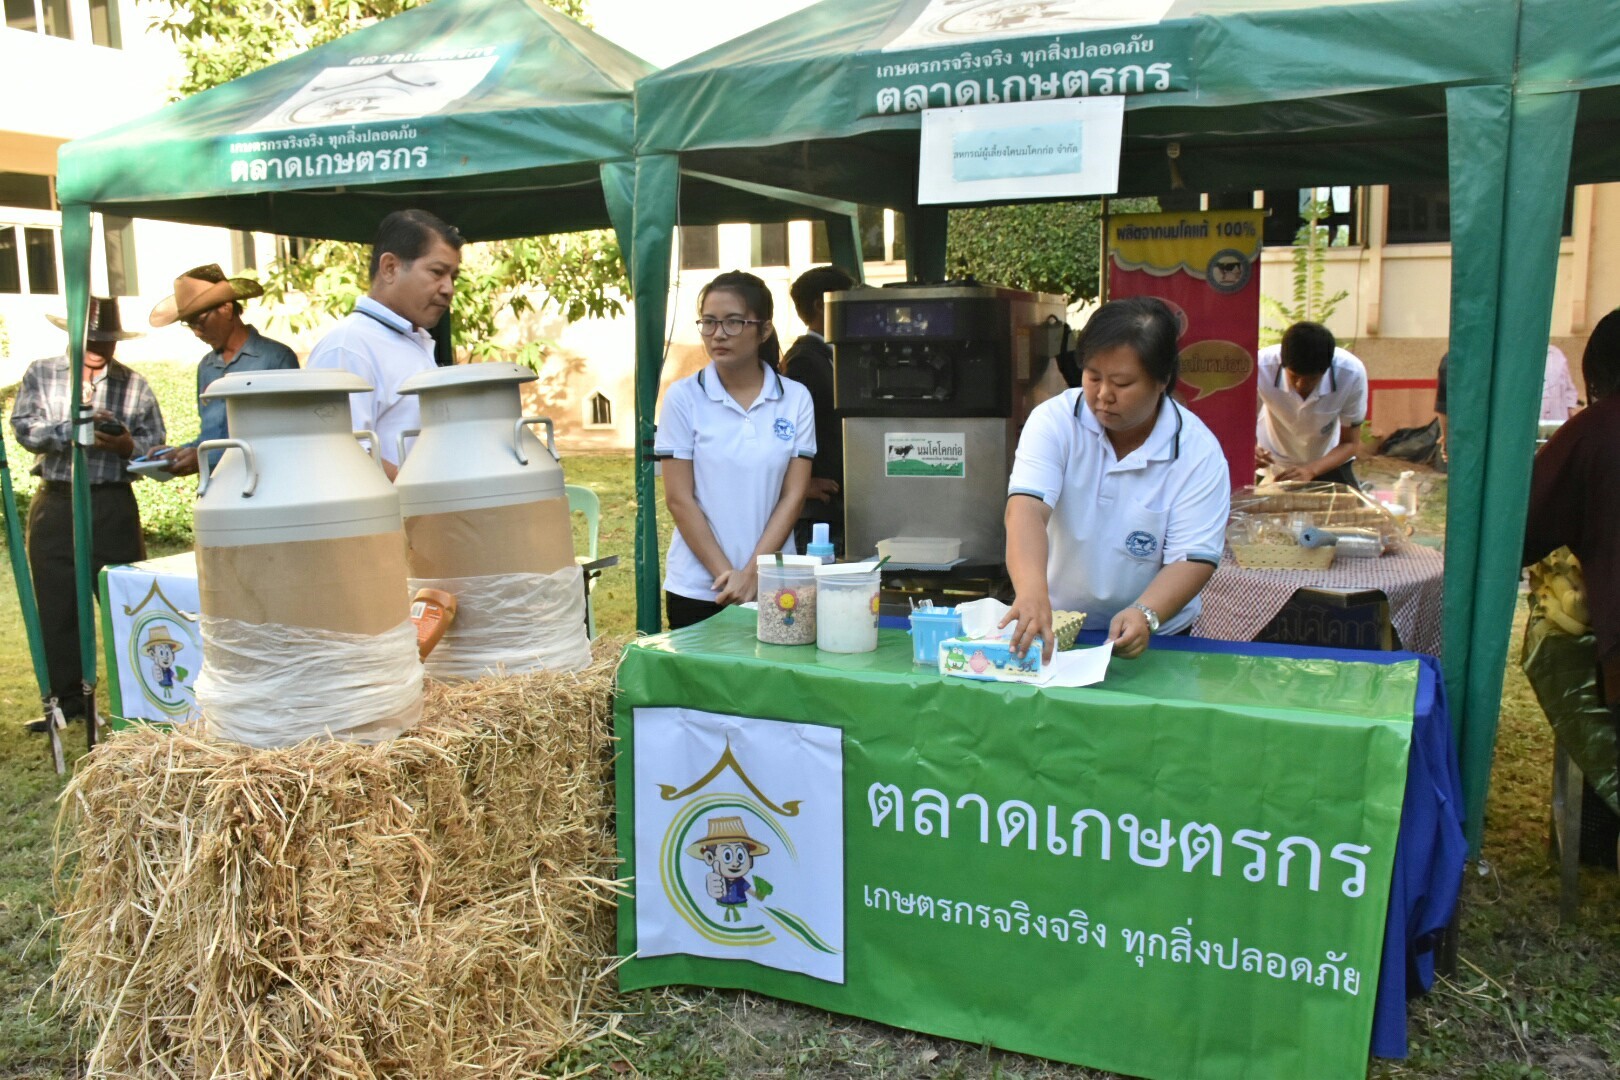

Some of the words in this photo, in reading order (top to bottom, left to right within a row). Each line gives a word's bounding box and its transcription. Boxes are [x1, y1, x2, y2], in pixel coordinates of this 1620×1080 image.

[876, 47, 1013, 79] เกษตรกรจริงจริง
[1020, 33, 1154, 69] ทุกสิ่งปลอดภัย
[876, 62, 1172, 114] ตลาดเกษตรกร
[328, 124, 417, 150] ทุกสิ่งปลอดภัย
[230, 145, 429, 183] ตลาดเกษตรกร
[1215, 222, 1256, 237] 100%
[867, 781, 1372, 899] ตลาดเกษตรกร
[863, 884, 1107, 948] เกษตรกรจริงจริง
[1121, 917, 1361, 996] ทุกสิ่งปลอดภัย
